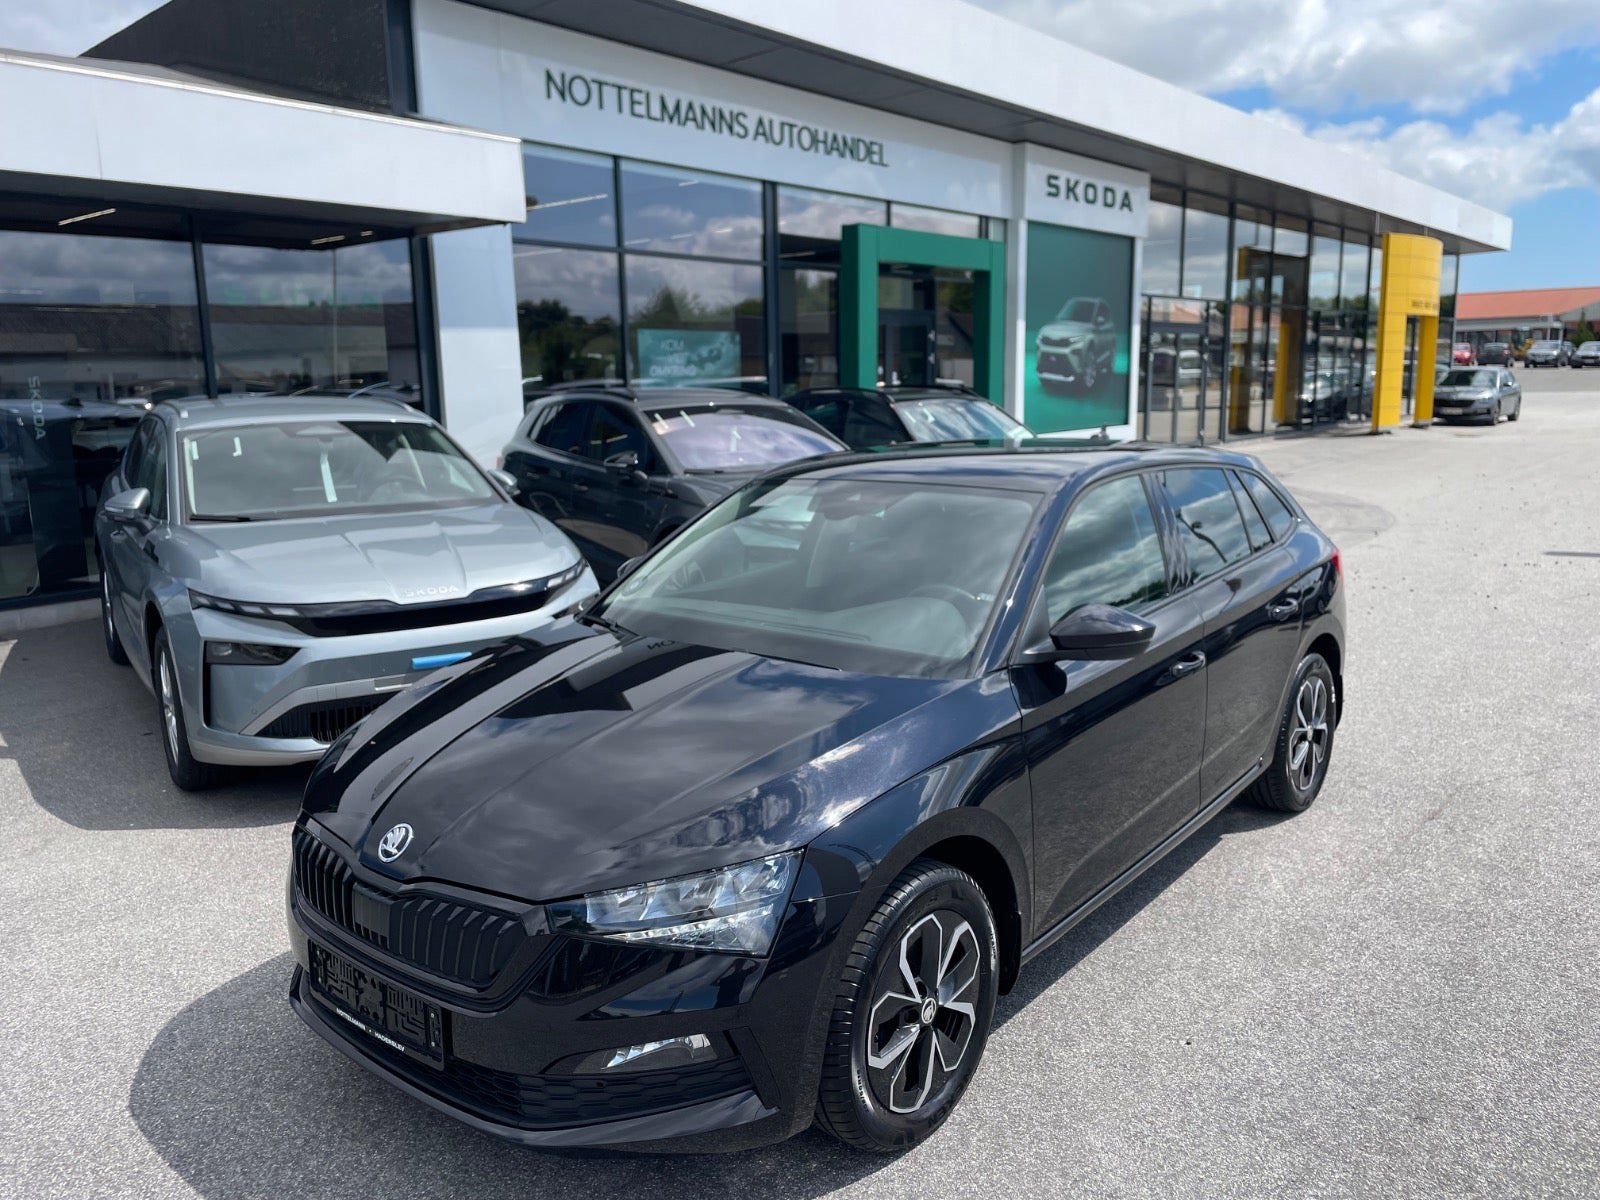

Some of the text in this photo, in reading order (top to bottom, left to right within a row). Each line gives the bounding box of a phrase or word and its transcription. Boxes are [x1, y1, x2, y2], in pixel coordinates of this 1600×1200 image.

[544, 68, 890, 168] NOTTELMANNS AUTOHANDEL
[1046, 173, 1133, 213] SKODA
[28, 375, 46, 441] SKODA
[404, 584, 459, 598] SKODA
